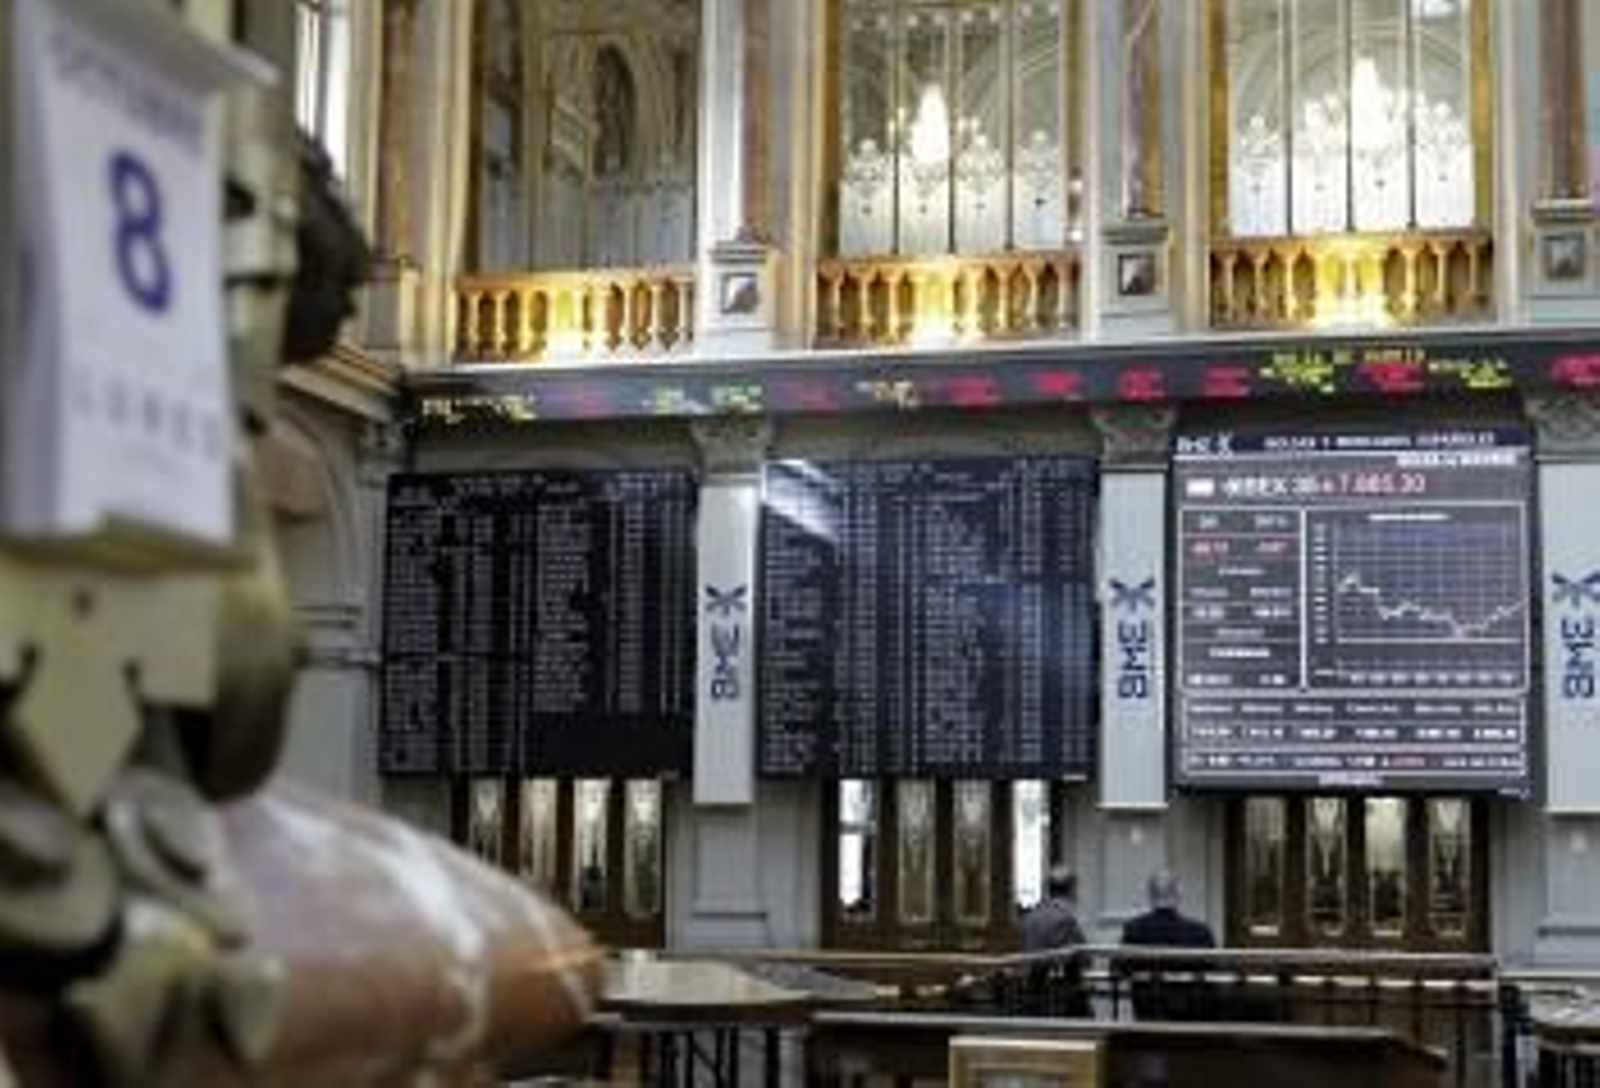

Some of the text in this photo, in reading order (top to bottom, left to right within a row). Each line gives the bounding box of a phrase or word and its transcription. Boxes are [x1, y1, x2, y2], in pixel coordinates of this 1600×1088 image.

[108, 149, 173, 315] 8
[710, 622, 741, 700] BME
[1117, 619, 1148, 699] BME
[1560, 616, 1595, 699] BME
